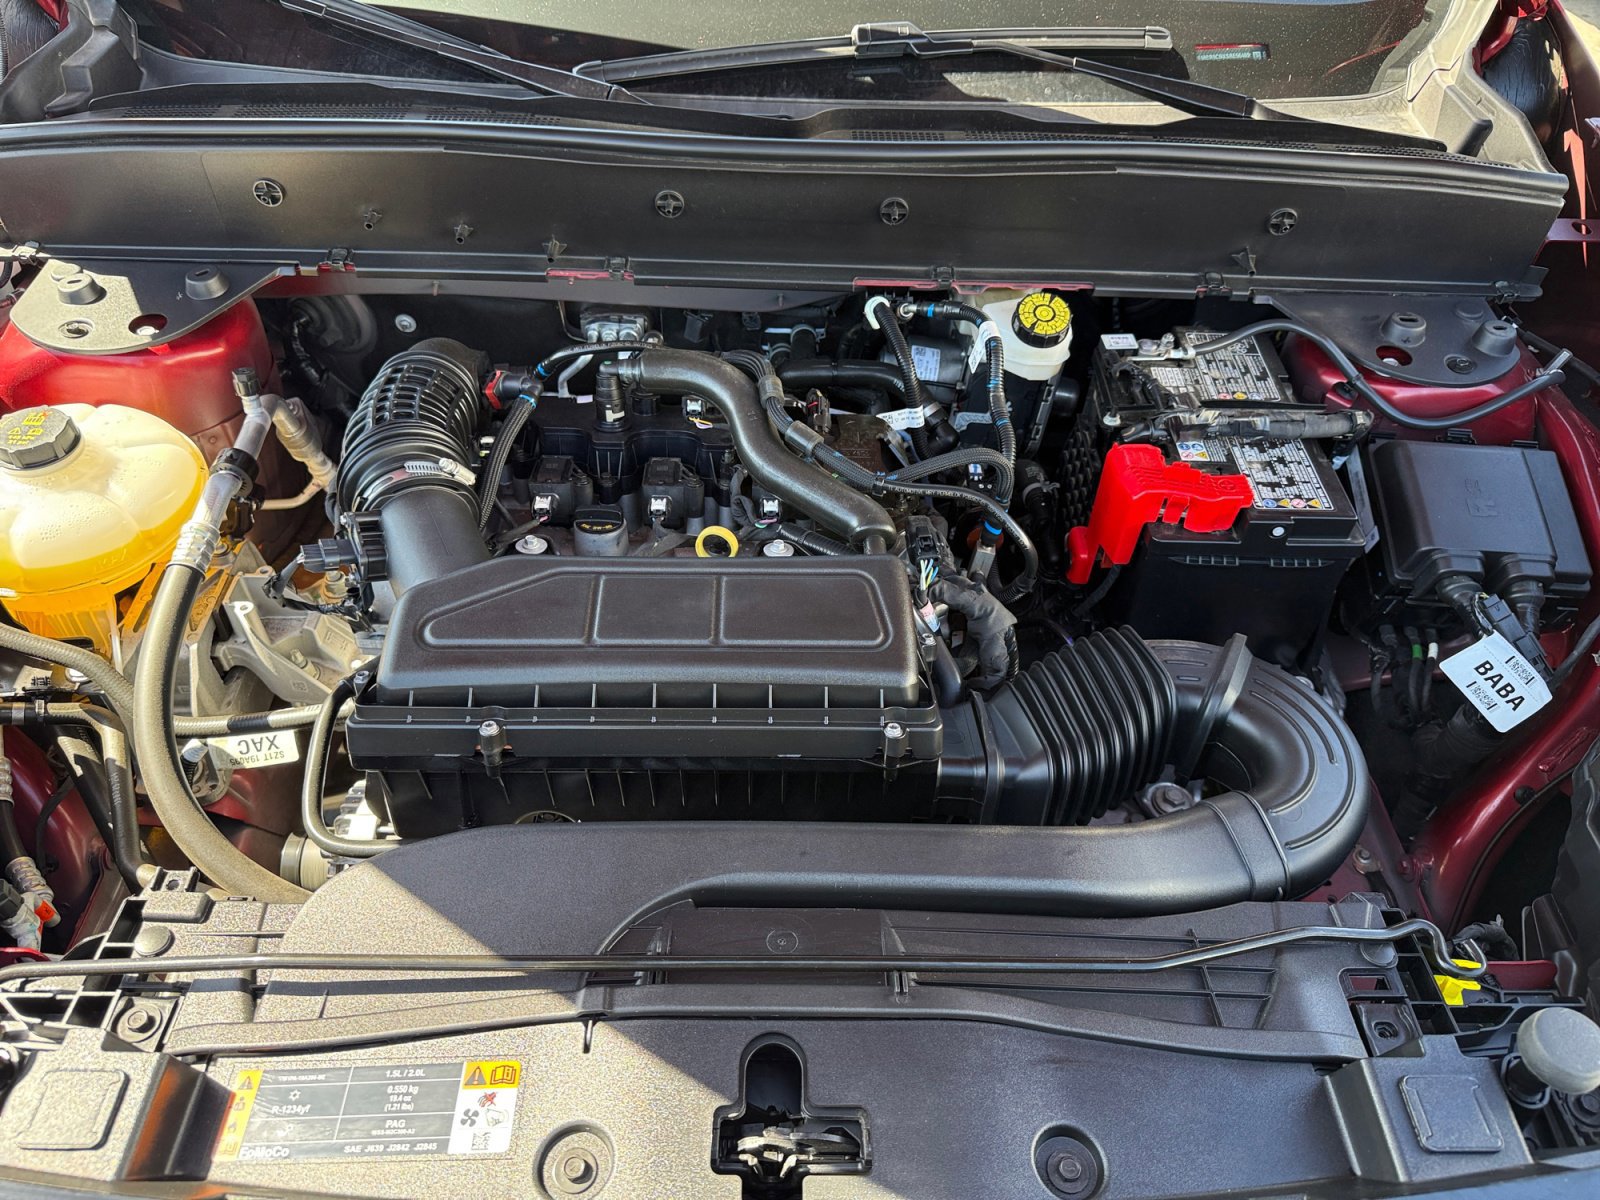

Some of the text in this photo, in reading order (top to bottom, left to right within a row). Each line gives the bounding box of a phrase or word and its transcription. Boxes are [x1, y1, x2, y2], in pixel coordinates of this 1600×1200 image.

[1474, 660, 1525, 711] BABA
[238, 735, 280, 755] XAC
[386, 1069, 402, 1078] 1.5L
[408, 1068, 426, 1077] 2.0L
[387, 1084, 420, 1095] 0.550 kg
[271, 1104, 312, 1115] R-1234yf
[384, 1103, 401, 1112] (1.21
[385, 1119, 406, 1129] PAG
[239, 1146, 290, 1159] FoMoCo
[343, 1142, 438, 1153] SAE J639 J2842 J2845
